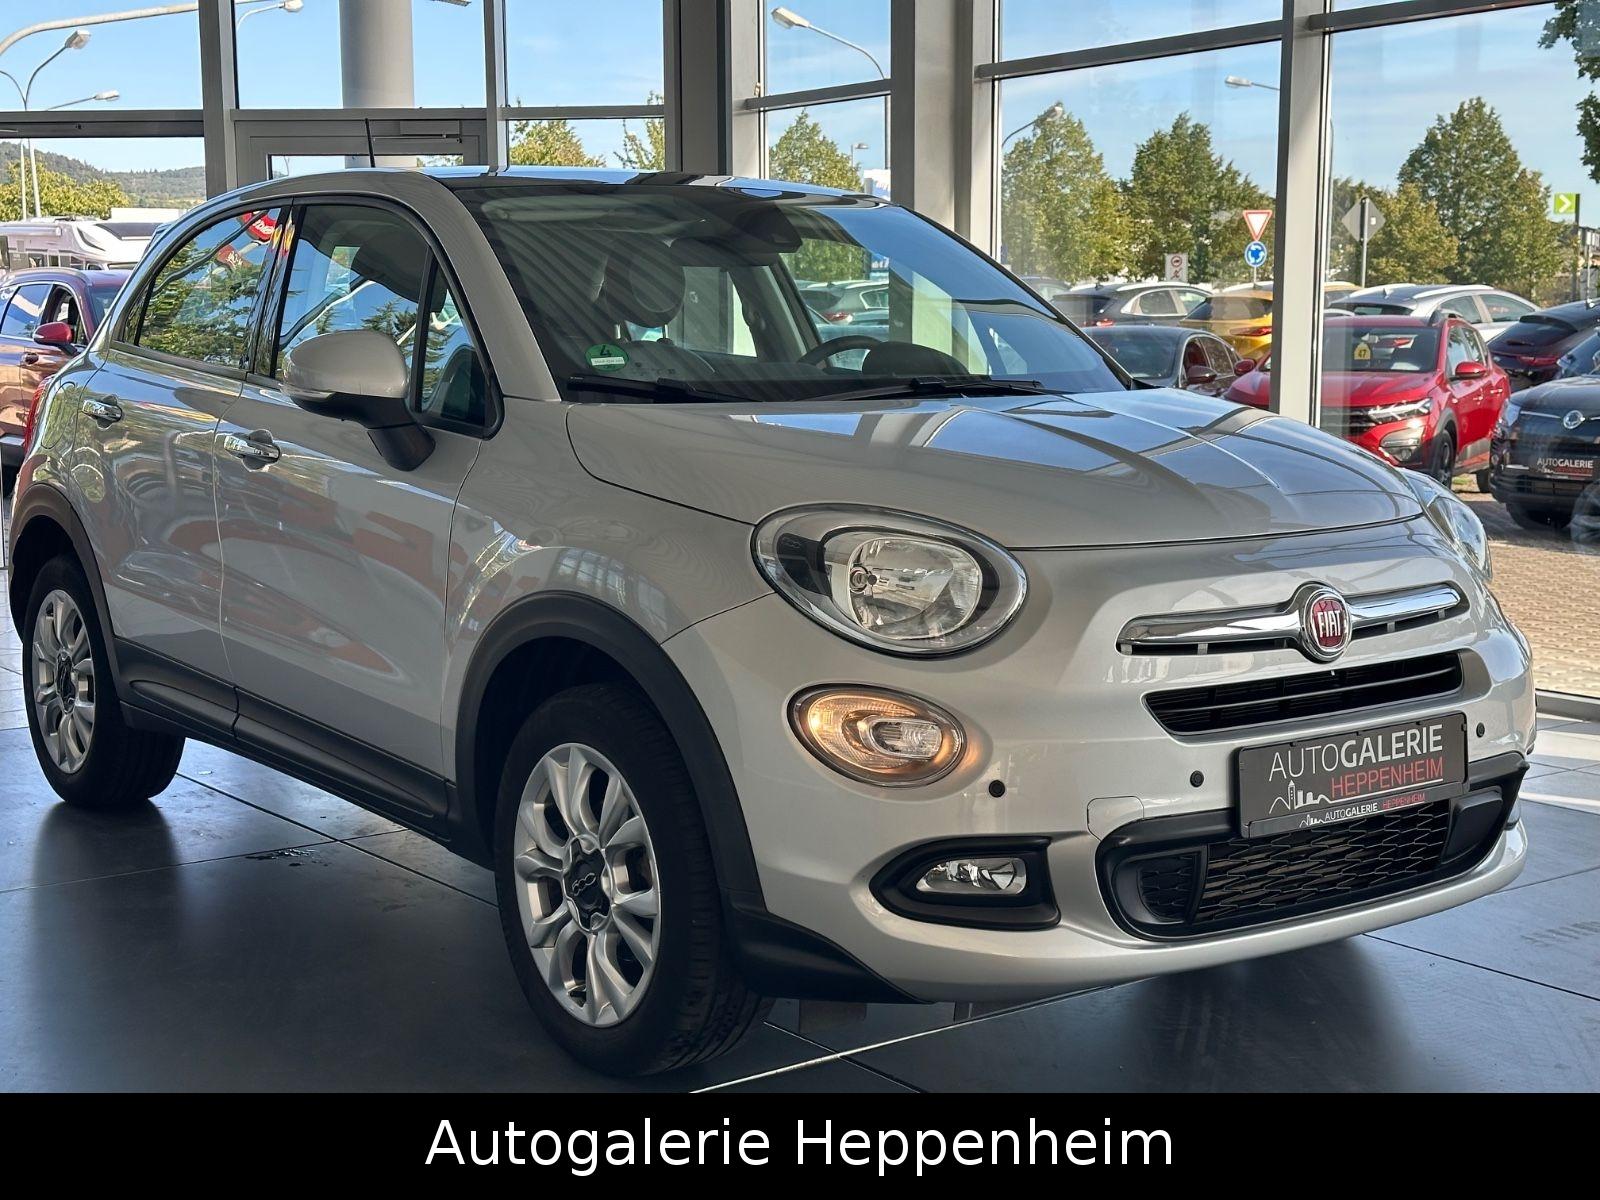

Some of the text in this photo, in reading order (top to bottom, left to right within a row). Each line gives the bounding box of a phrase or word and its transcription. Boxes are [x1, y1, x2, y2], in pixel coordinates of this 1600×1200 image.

[1537, 457, 1594, 469] AUTOGALERIE
[1317, 610, 1341, 638] FIAT
[1268, 724, 1443, 782] AUTOGALERIE
[1331, 756, 1444, 798] HEPPENHEIM
[1324, 802, 1379, 822] AUTOGALERIE
